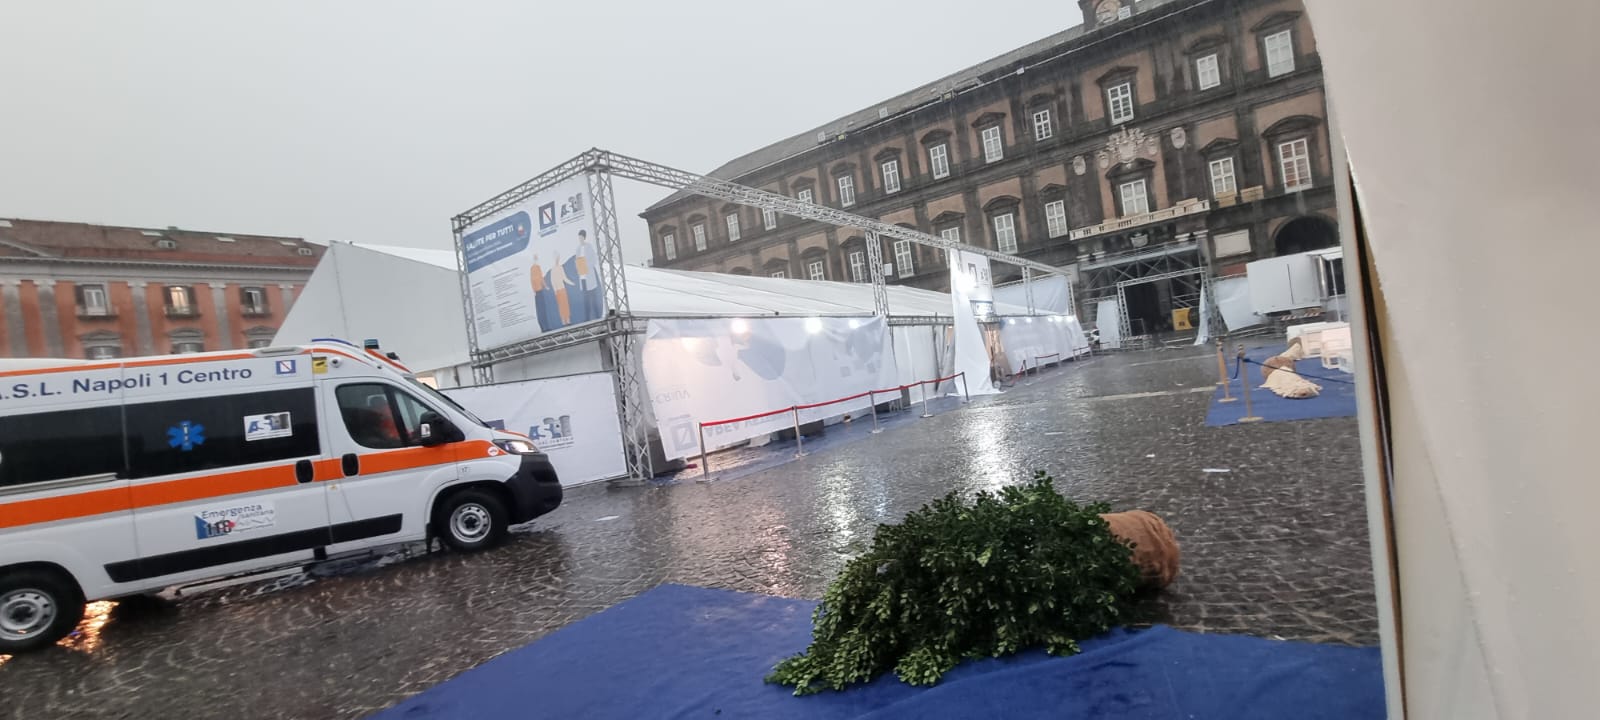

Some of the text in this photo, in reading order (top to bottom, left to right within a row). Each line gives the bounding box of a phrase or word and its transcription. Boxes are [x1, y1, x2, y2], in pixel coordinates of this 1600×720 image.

[497, 224, 514, 236] TUTTI
[0, 367, 253, 400] .S.L. Napoli 1 Centro
[201, 504, 262, 519] Emergenza
[206, 519, 232, 536] 118
